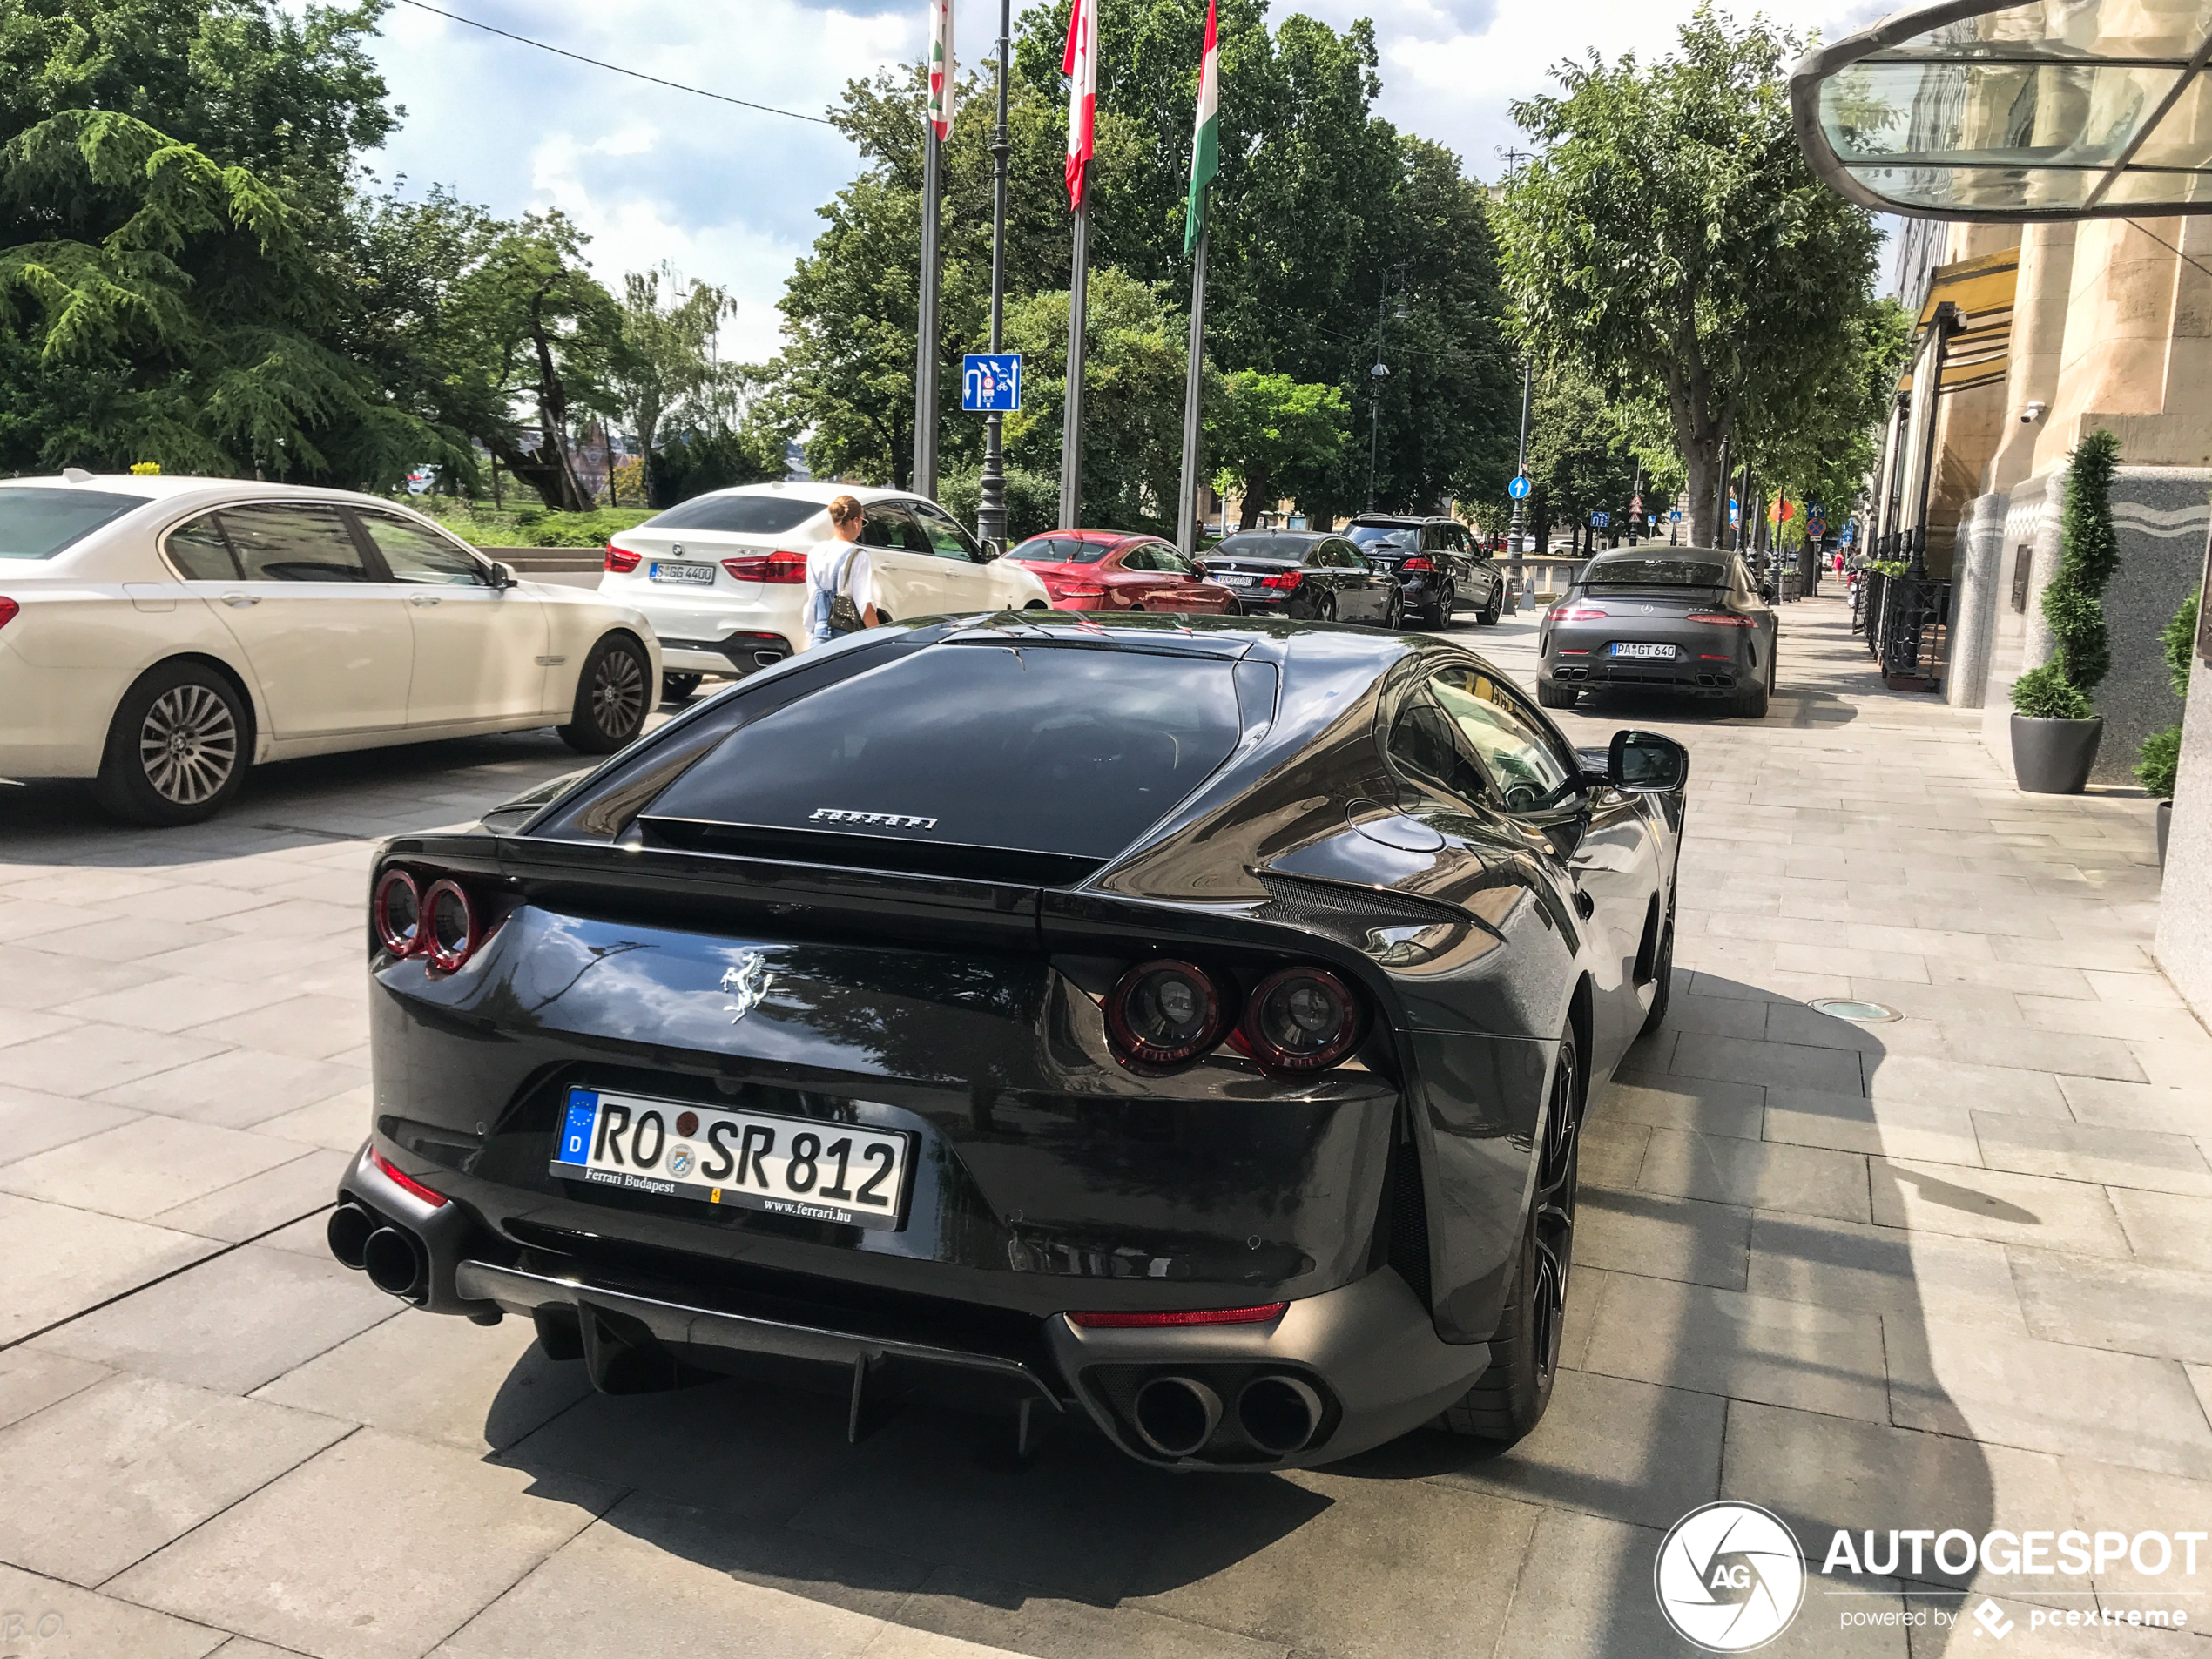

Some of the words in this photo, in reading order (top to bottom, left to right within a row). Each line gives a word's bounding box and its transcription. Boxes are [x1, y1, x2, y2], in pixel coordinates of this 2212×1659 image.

[657, 565, 664, 577] S
[669, 566, 684, 578] GG
[685, 567, 711, 580] 4400
[1617, 644, 1630, 654] PA
[1638, 645, 1652, 655] GT
[1655, 646, 1674, 656] 640
[569, 1136, 582, 1153] D
[593, 1103, 664, 1169] RO
[701, 1121, 775, 1189] SR
[786, 1131, 895, 1206] 812
[585, 1168, 622, 1184] Ferrari
[624, 1175, 675, 1193] Budapest
[764, 1199, 852, 1223] www.ferrari.hu
